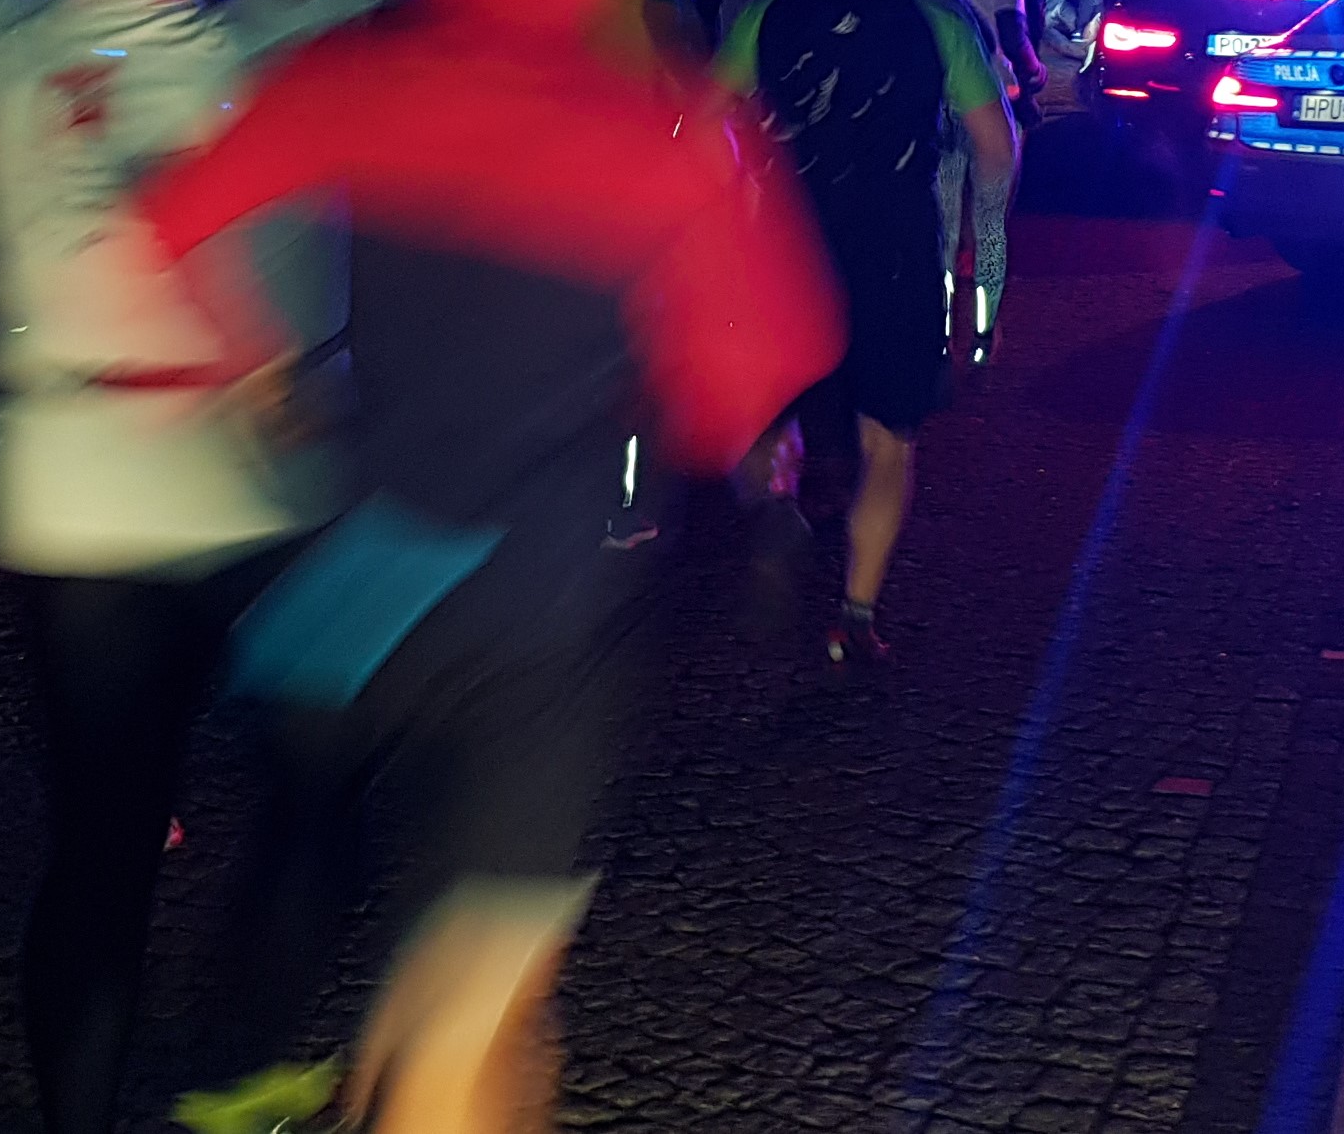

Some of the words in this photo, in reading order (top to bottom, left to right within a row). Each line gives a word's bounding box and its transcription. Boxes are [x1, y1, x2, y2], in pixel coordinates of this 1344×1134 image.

[1220, 37, 1243, 54] PO
[1274, 64, 1320, 82] POLICJA
[1305, 98, 1343, 120] HPU
